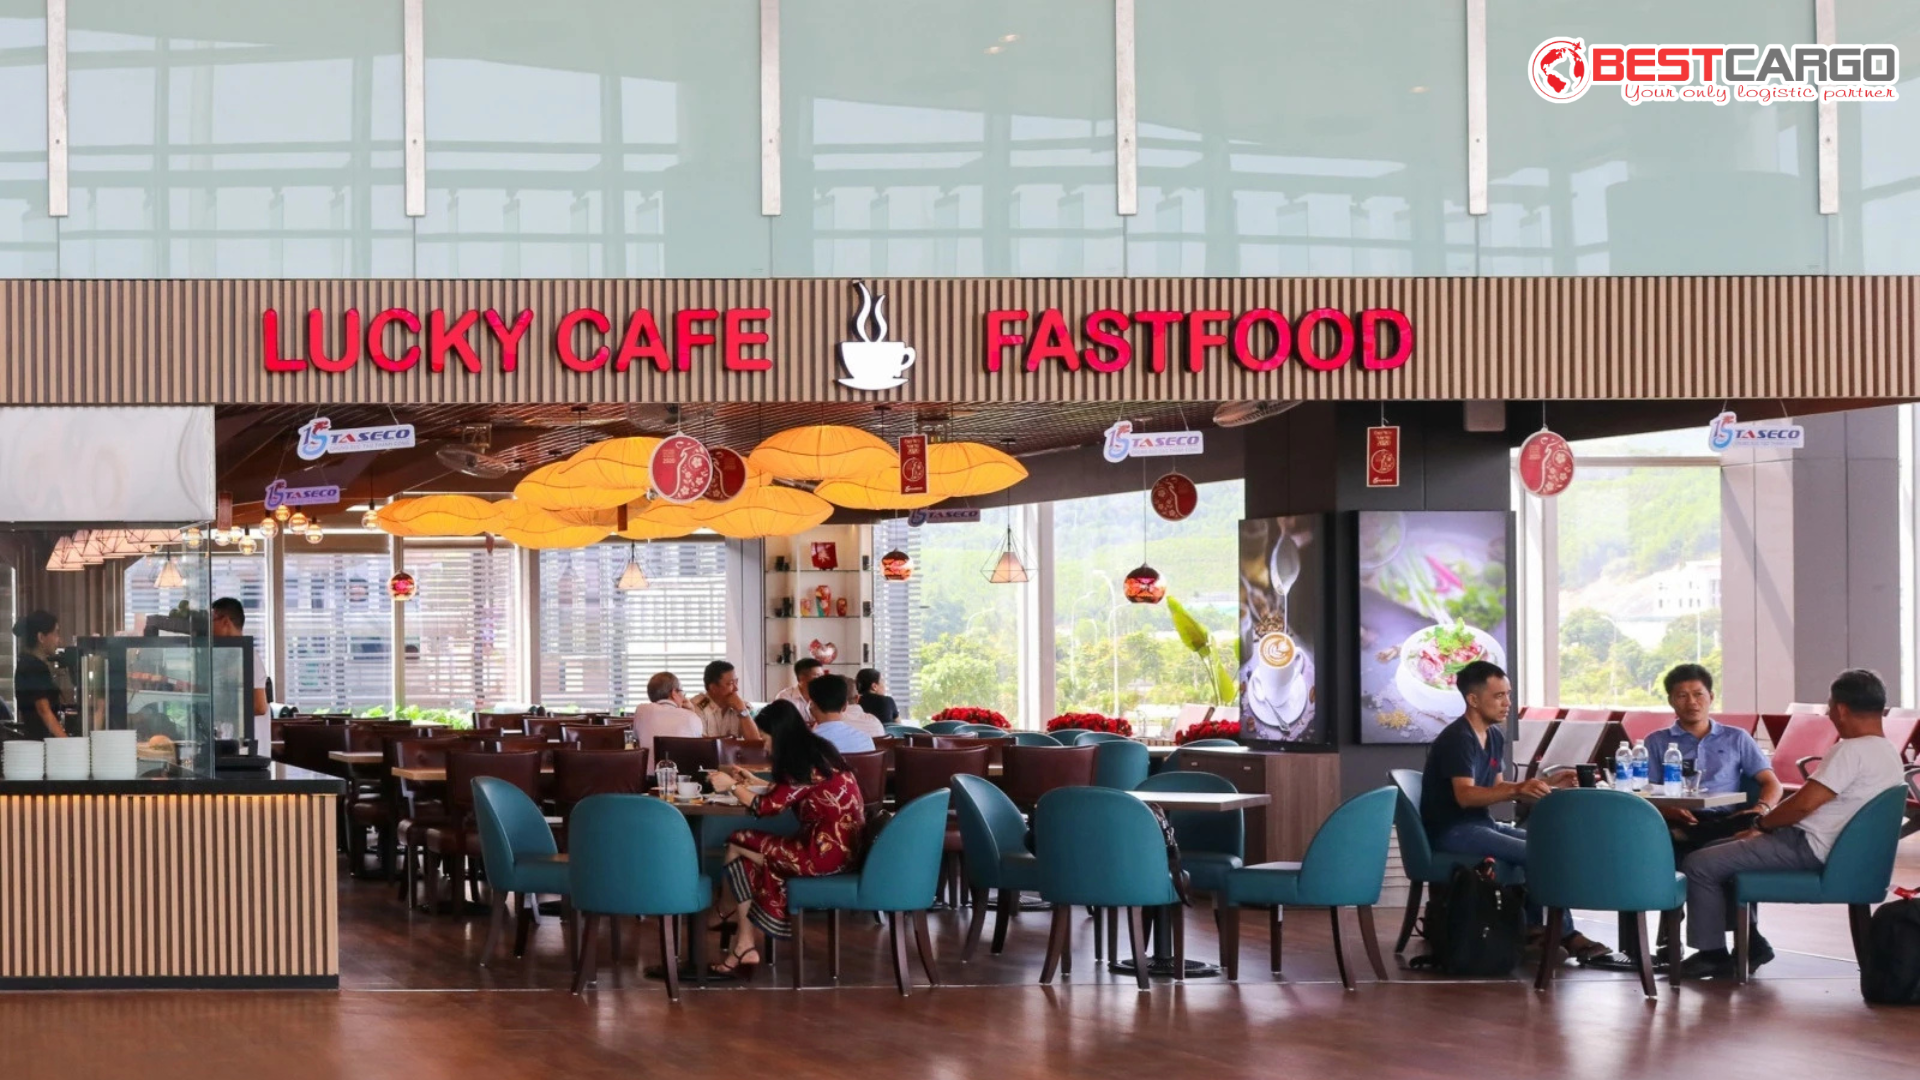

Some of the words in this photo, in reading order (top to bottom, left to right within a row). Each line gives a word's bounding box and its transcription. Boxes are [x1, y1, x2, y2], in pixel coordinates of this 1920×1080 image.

[263, 307, 533, 373] LUCKY
[556, 307, 773, 373] CAFE
[986, 307, 1413, 373] FASTFOOD
[330, 429, 410, 443] TASECO
[1736, 429, 1800, 439] TASECO
[1132, 436, 1199, 447] TASECO
[286, 489, 337, 499] TASECO
[928, 510, 978, 518] TASECO
